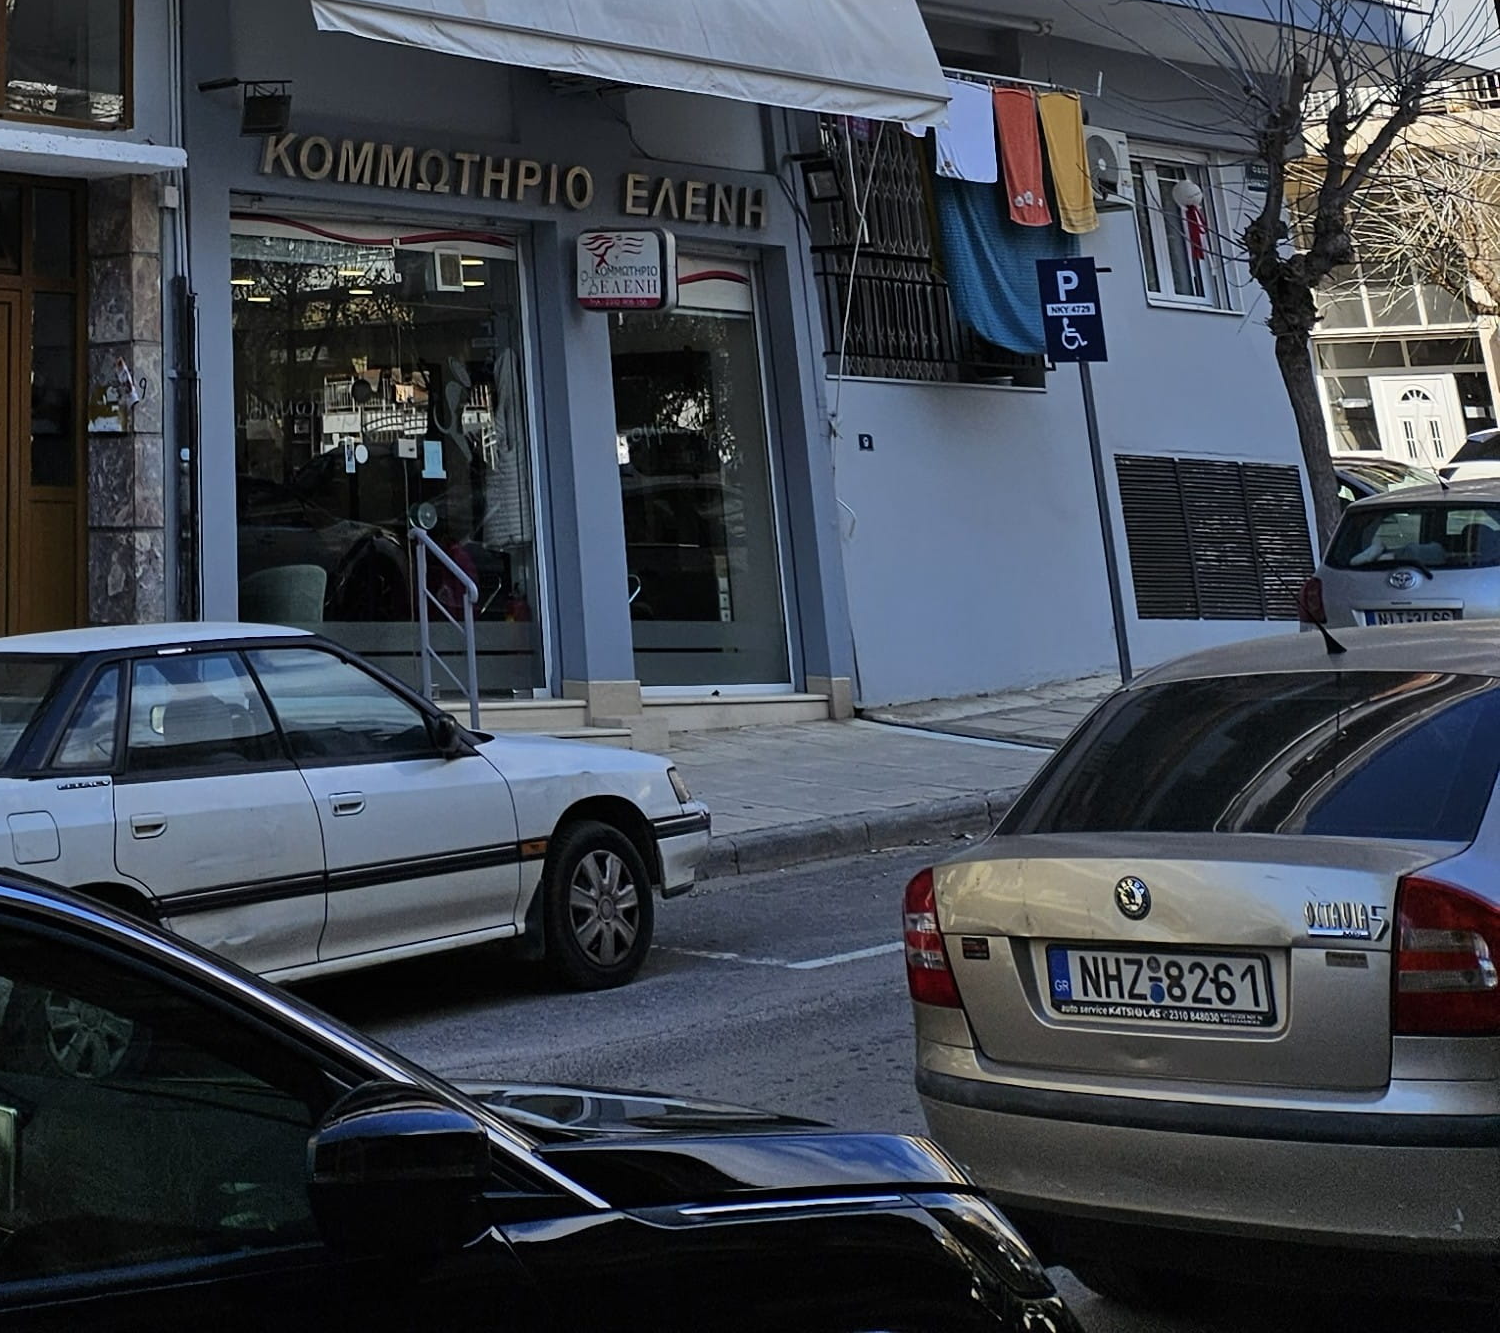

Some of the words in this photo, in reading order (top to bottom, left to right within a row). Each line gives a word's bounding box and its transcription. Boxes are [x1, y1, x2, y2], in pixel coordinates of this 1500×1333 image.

[261, 133, 594, 210] ΚΟΜΜΩΤΗΡΙΟ
[624, 172, 768, 227] ΕΛΕΝΗ
[595, 264, 658, 277] ΚΟΜΜΩΤΗΡΙΟ
[600, 278, 657, 294] ΕΛΕΝΗ
[1056, 270, 1079, 302] P
[1304, 900, 1370, 930] OCTAVIA
[1054, 980, 1069, 992] GR
[1061, 1004, 1079, 1013] auto
[1080, 1005, 1108, 1014] service
[1169, 1009, 1189, 1021] 2310
